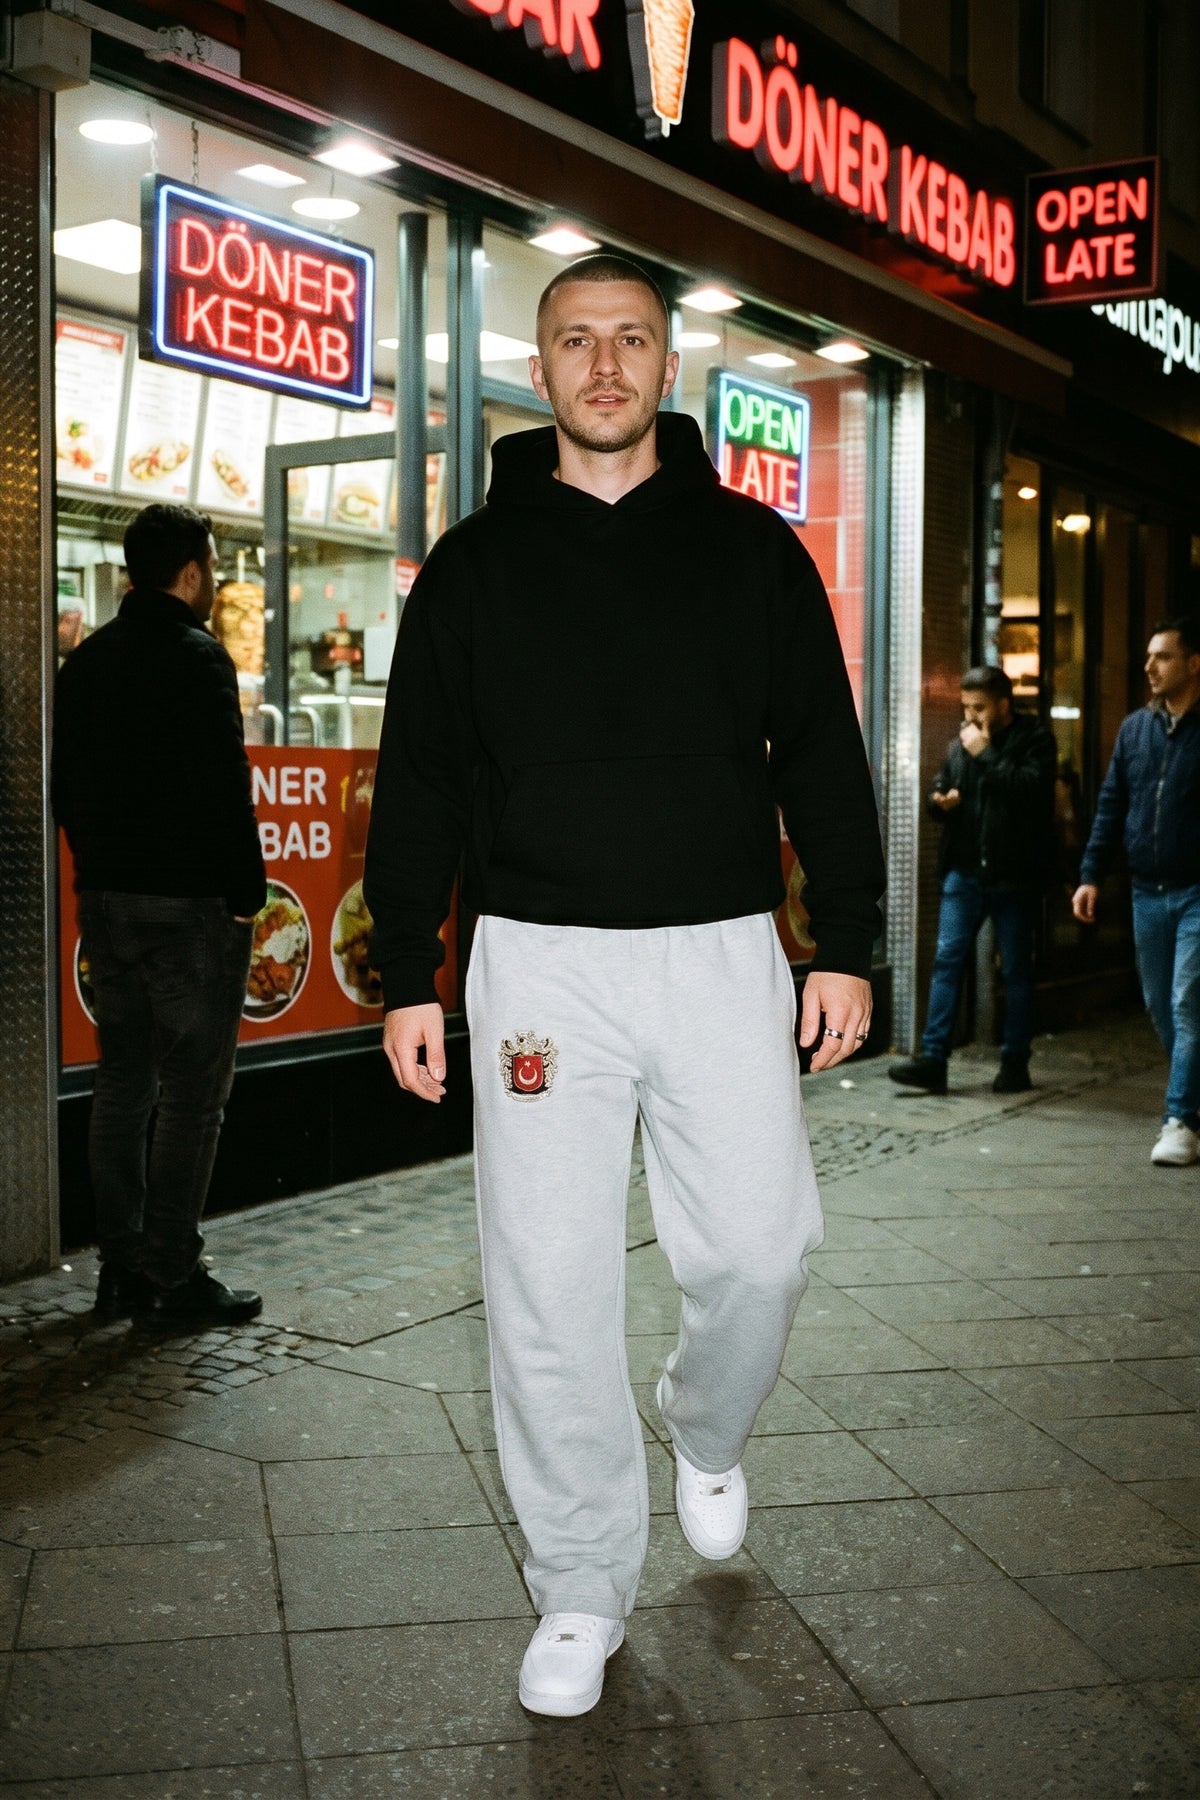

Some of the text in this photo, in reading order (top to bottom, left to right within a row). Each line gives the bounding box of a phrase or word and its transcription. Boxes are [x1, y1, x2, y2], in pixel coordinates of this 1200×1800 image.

[727, 35, 1015, 286] DÖNER KEBAB
[1037, 177, 1148, 232] OPEN
[180, 218, 356, 322] DÖNER
[1045, 233, 1136, 284] LATE
[186, 287, 350, 381] KEBAB
[725, 388, 802, 455] OPEN
[723, 443, 799, 511] LATE
[252, 765, 327, 806] NER
[258, 821, 332, 861] BAB
